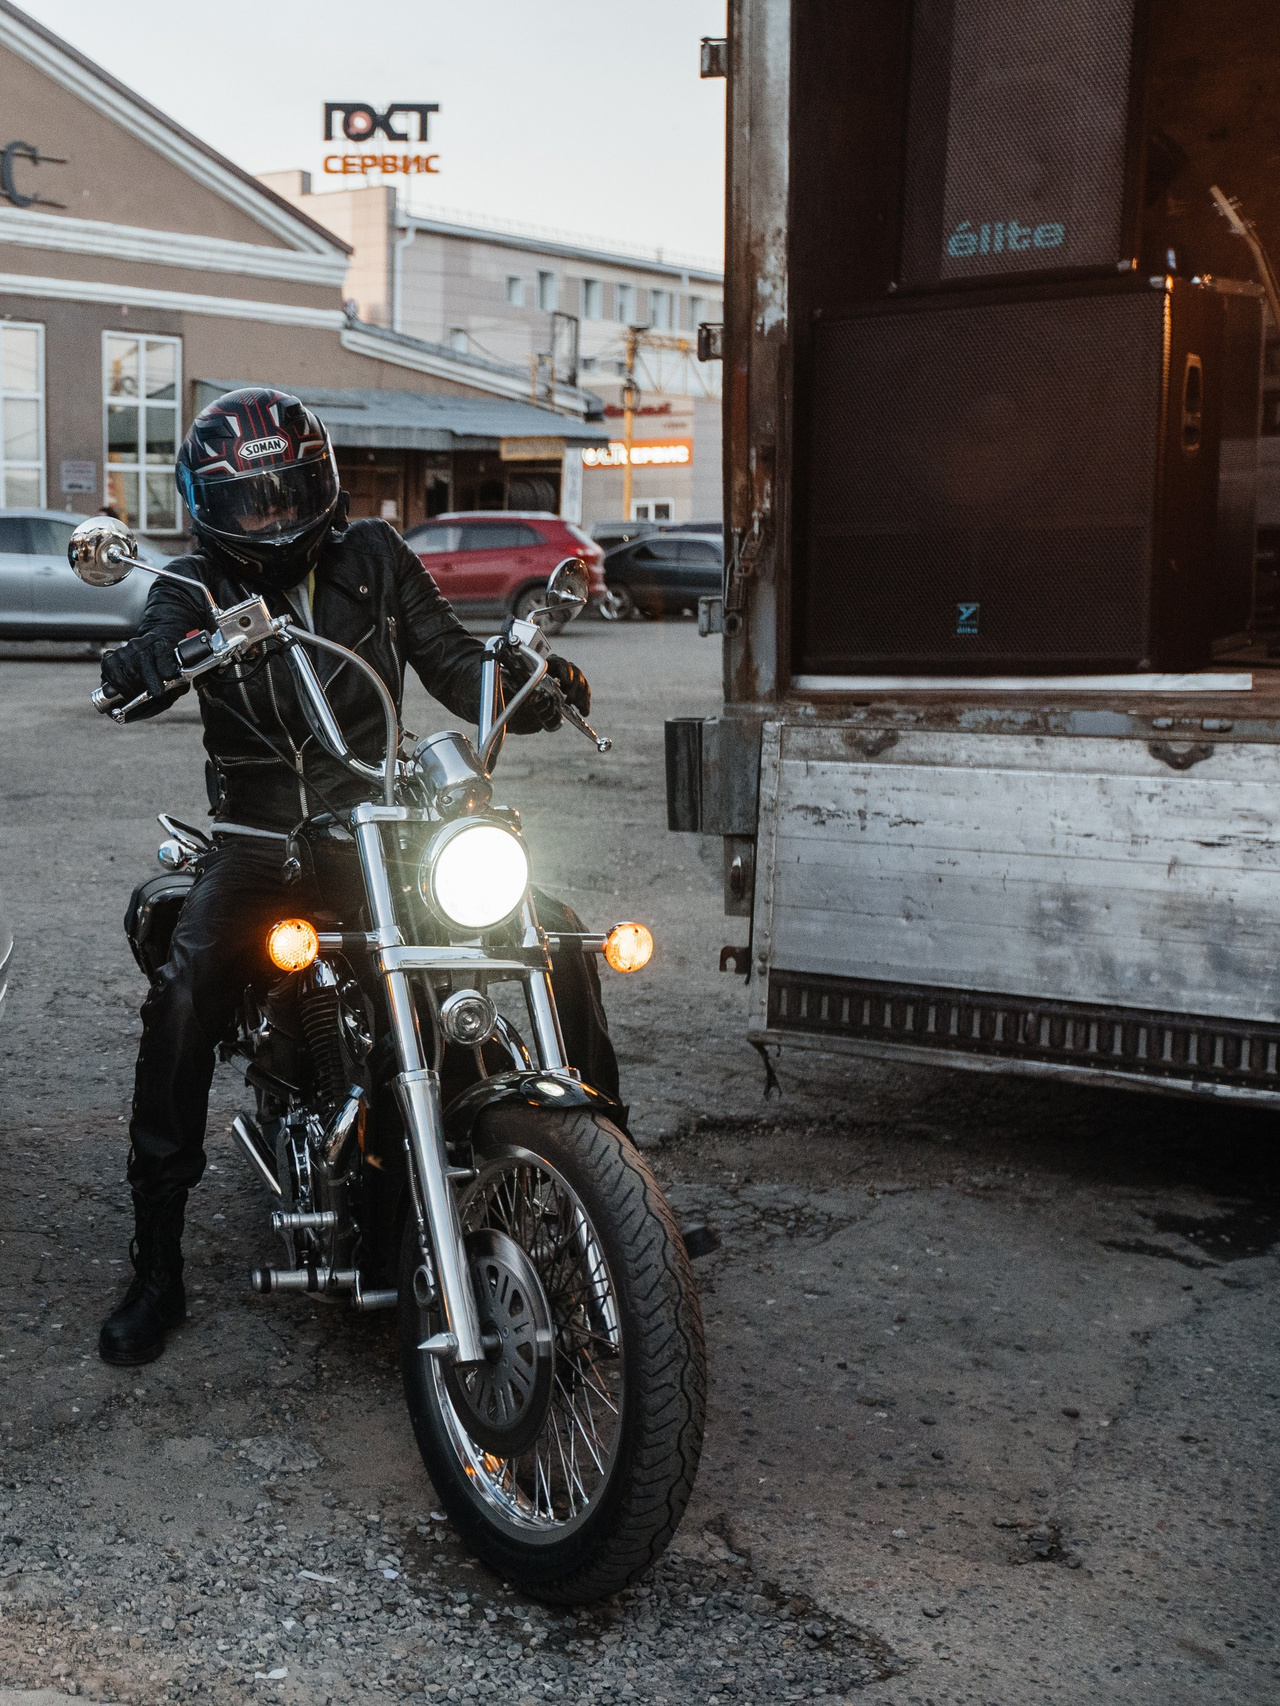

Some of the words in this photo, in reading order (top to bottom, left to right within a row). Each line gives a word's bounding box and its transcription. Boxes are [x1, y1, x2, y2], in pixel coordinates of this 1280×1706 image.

[323, 102, 439, 142] ГОСТ
[323, 154, 440, 175] СЕРВИС
[947, 220, 1066, 257] élite
[244, 439, 282, 456] SOMAN
